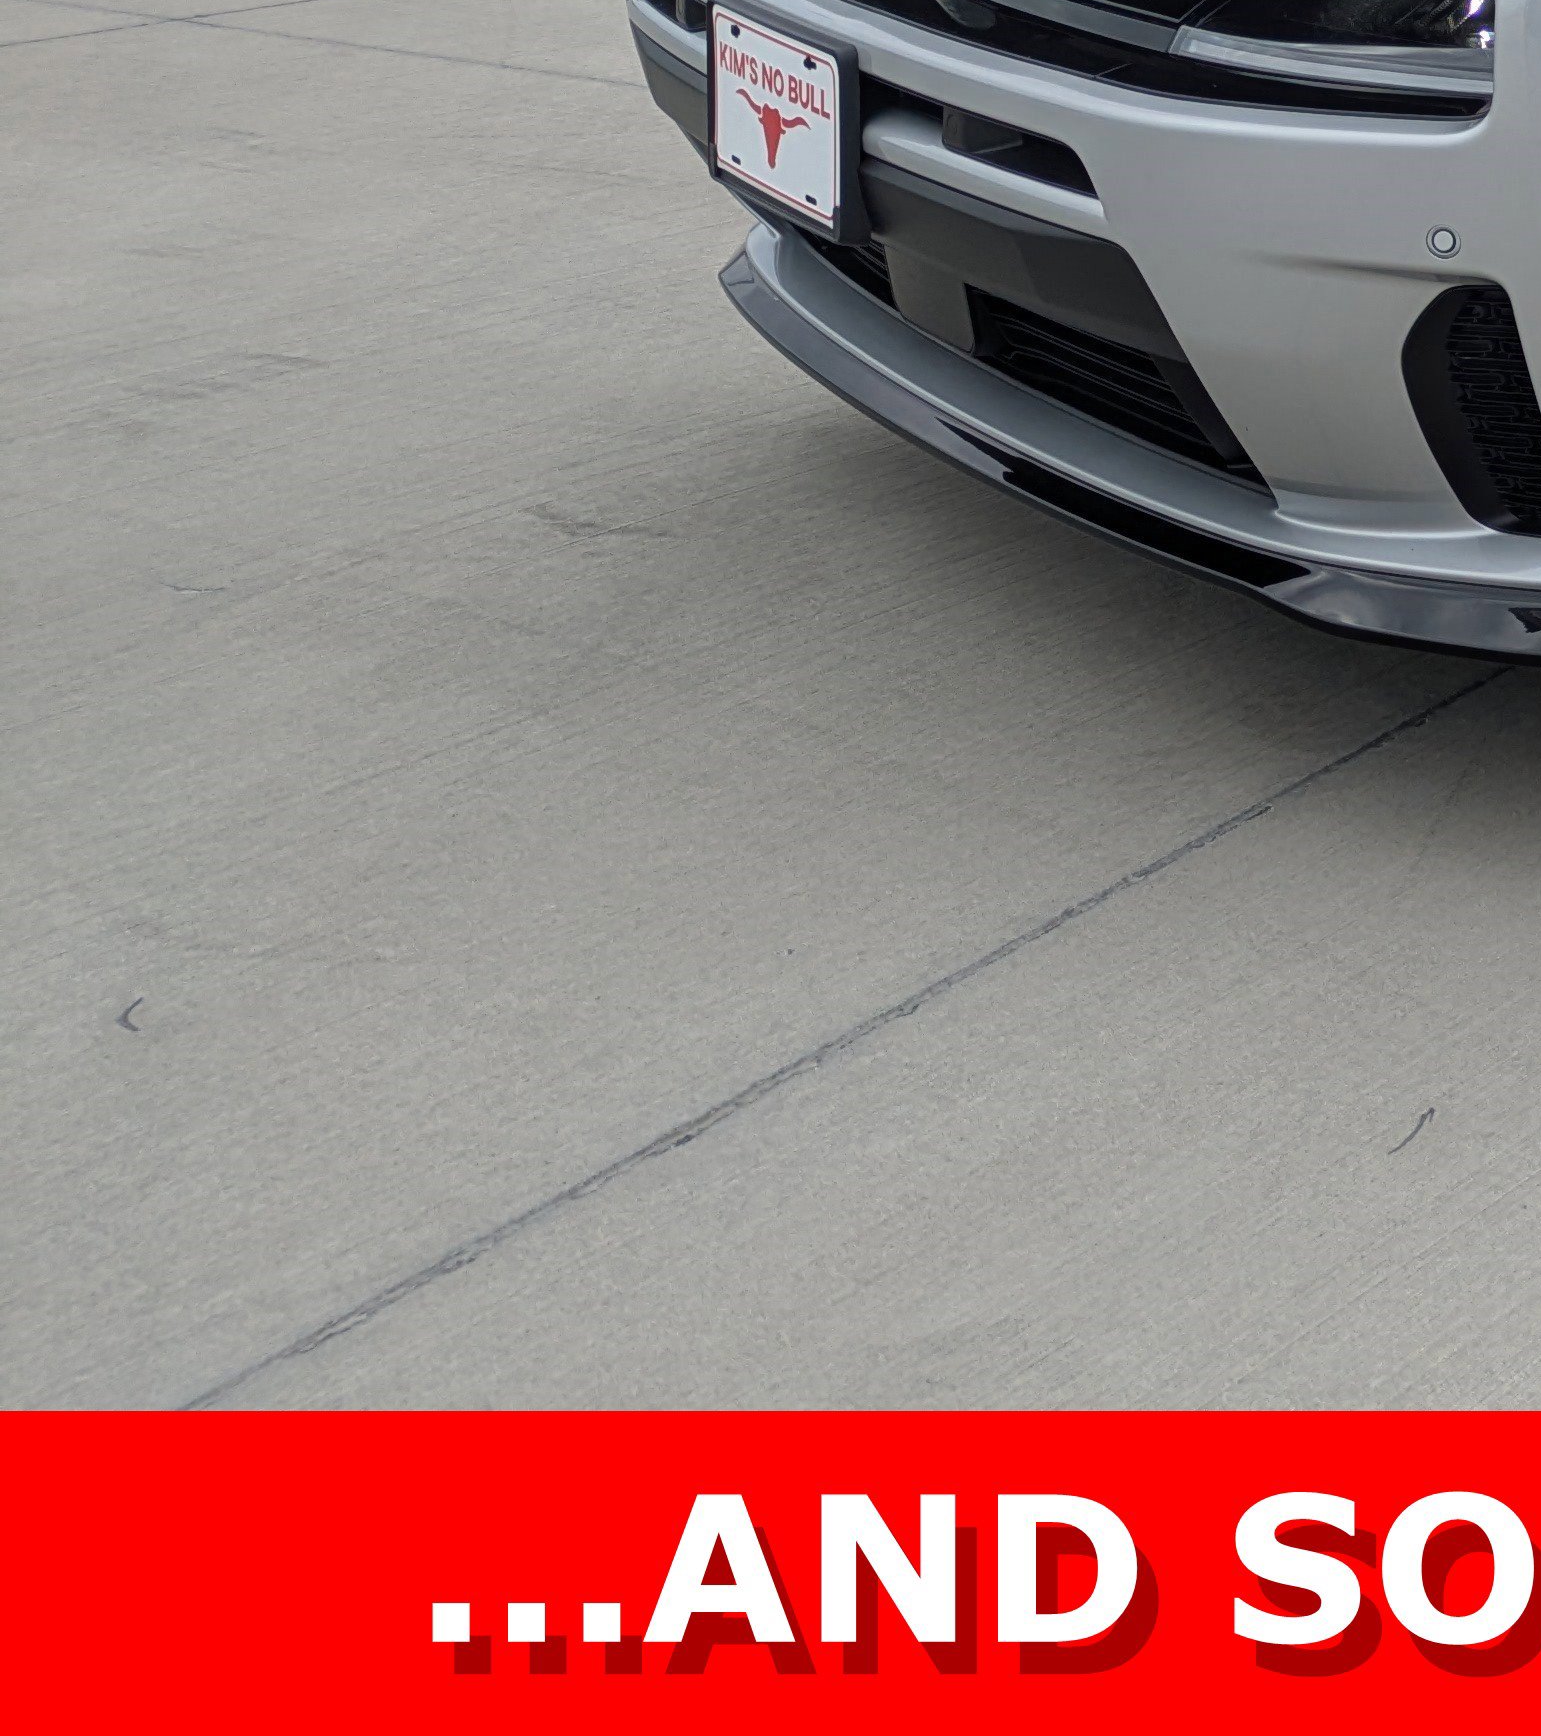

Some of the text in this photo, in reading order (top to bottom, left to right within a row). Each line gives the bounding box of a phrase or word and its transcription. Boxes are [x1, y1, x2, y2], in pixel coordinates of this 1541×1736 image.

[719, 40, 831, 120] KIM'S NO BULL
